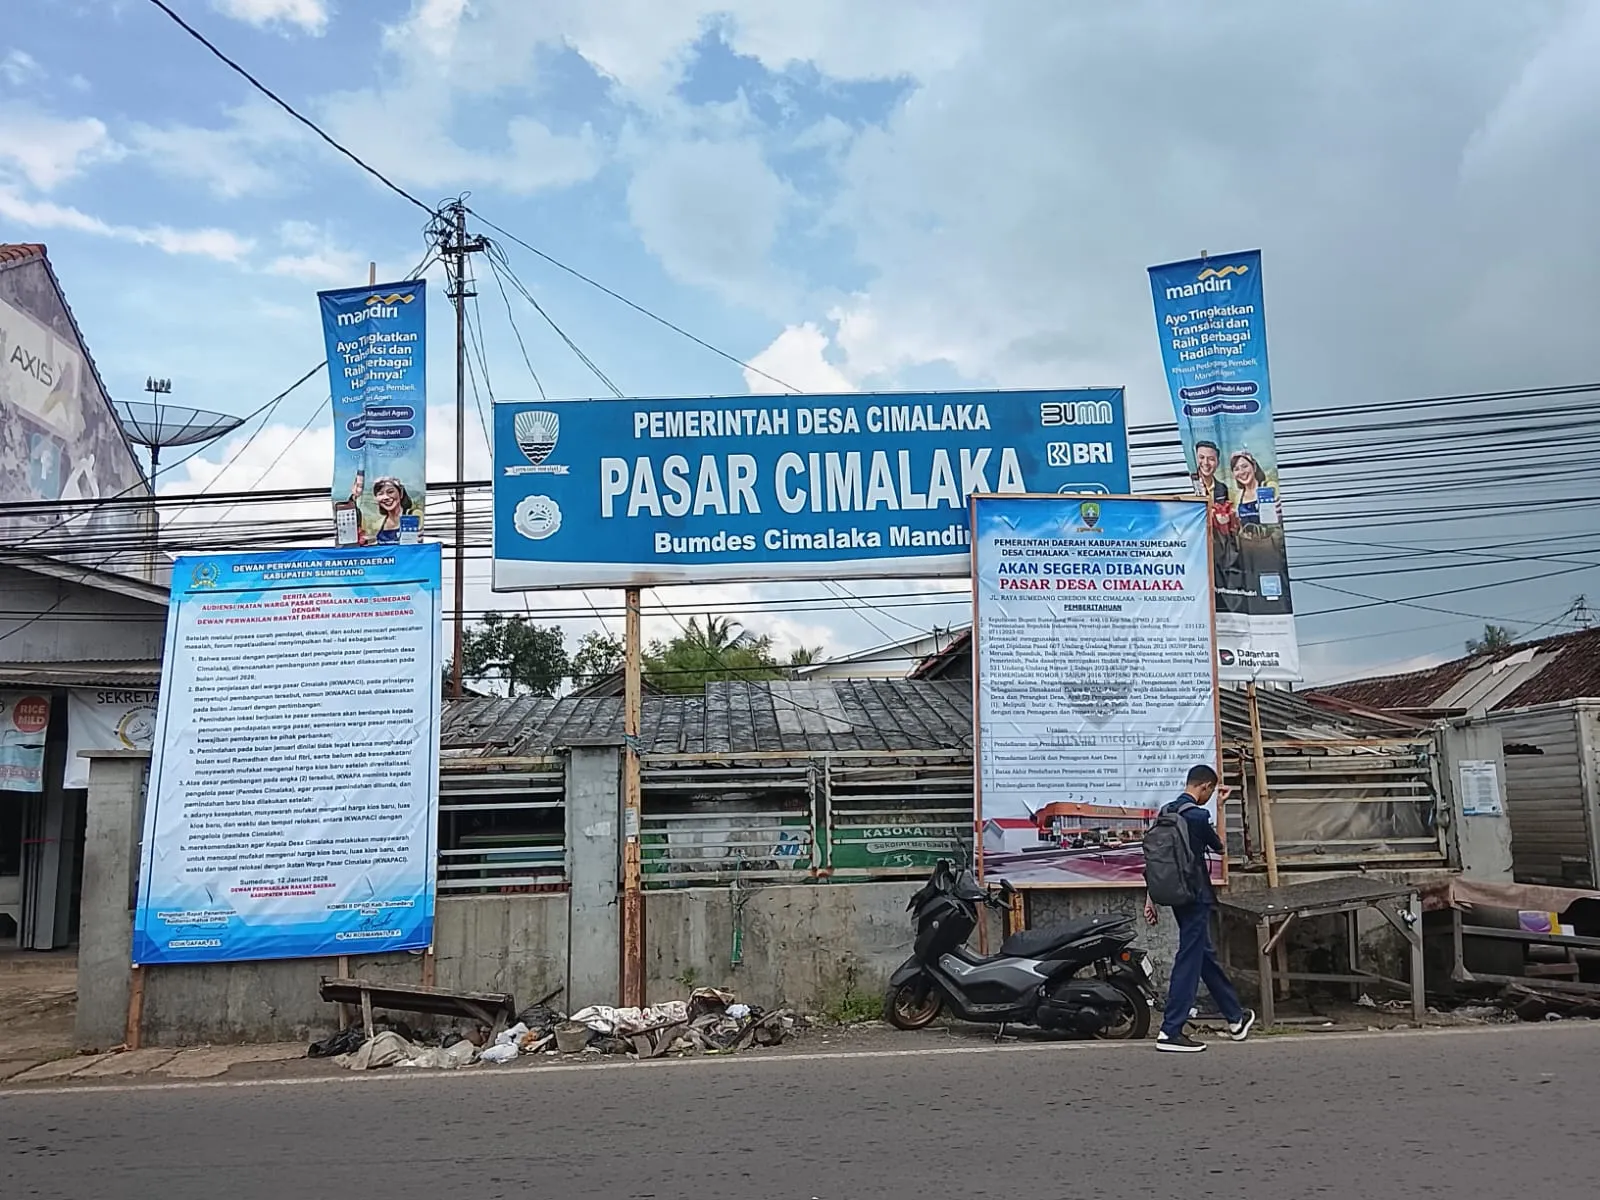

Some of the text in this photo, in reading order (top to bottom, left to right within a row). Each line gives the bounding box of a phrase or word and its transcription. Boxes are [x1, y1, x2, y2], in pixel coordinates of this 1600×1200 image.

[1166, 277, 1231, 300] mandiri
[337, 303, 398, 327] mandiri
[1165, 305, 1254, 326] Ayo Tingkatkan
[1171, 318, 1249, 337] Transaksi dan
[337, 341, 358, 354] Ayo
[388, 344, 412, 355] dan
[1172, 330, 1251, 350] Raih Berbagai
[9, 345, 53, 387] AXIS
[344, 357, 413, 378] Raih erbagai
[633, 404, 991, 438] PEMERINTAH DESA CIMALAKA
[1072, 442, 1113, 464] BRI
[600, 447, 1026, 518] PASAR CIMALAKA
[654, 530, 757, 554] Bumdes
[764, 527, 881, 551] Cimalaka
[994, 538, 1049, 546] PEMERINTAH
[1001, 548, 1023, 556] DESA
[315, 569, 362, 577] SUMEDANG
[998, 562, 1185, 575] AKAN SEGERA DIBANGUN
[999, 578, 1184, 590] PASAR DESA CIMALAKA
[371, 595, 410, 603] SUMEDANG
[20, 704, 46, 715] RICE
[18, 715, 46, 726] MILD
